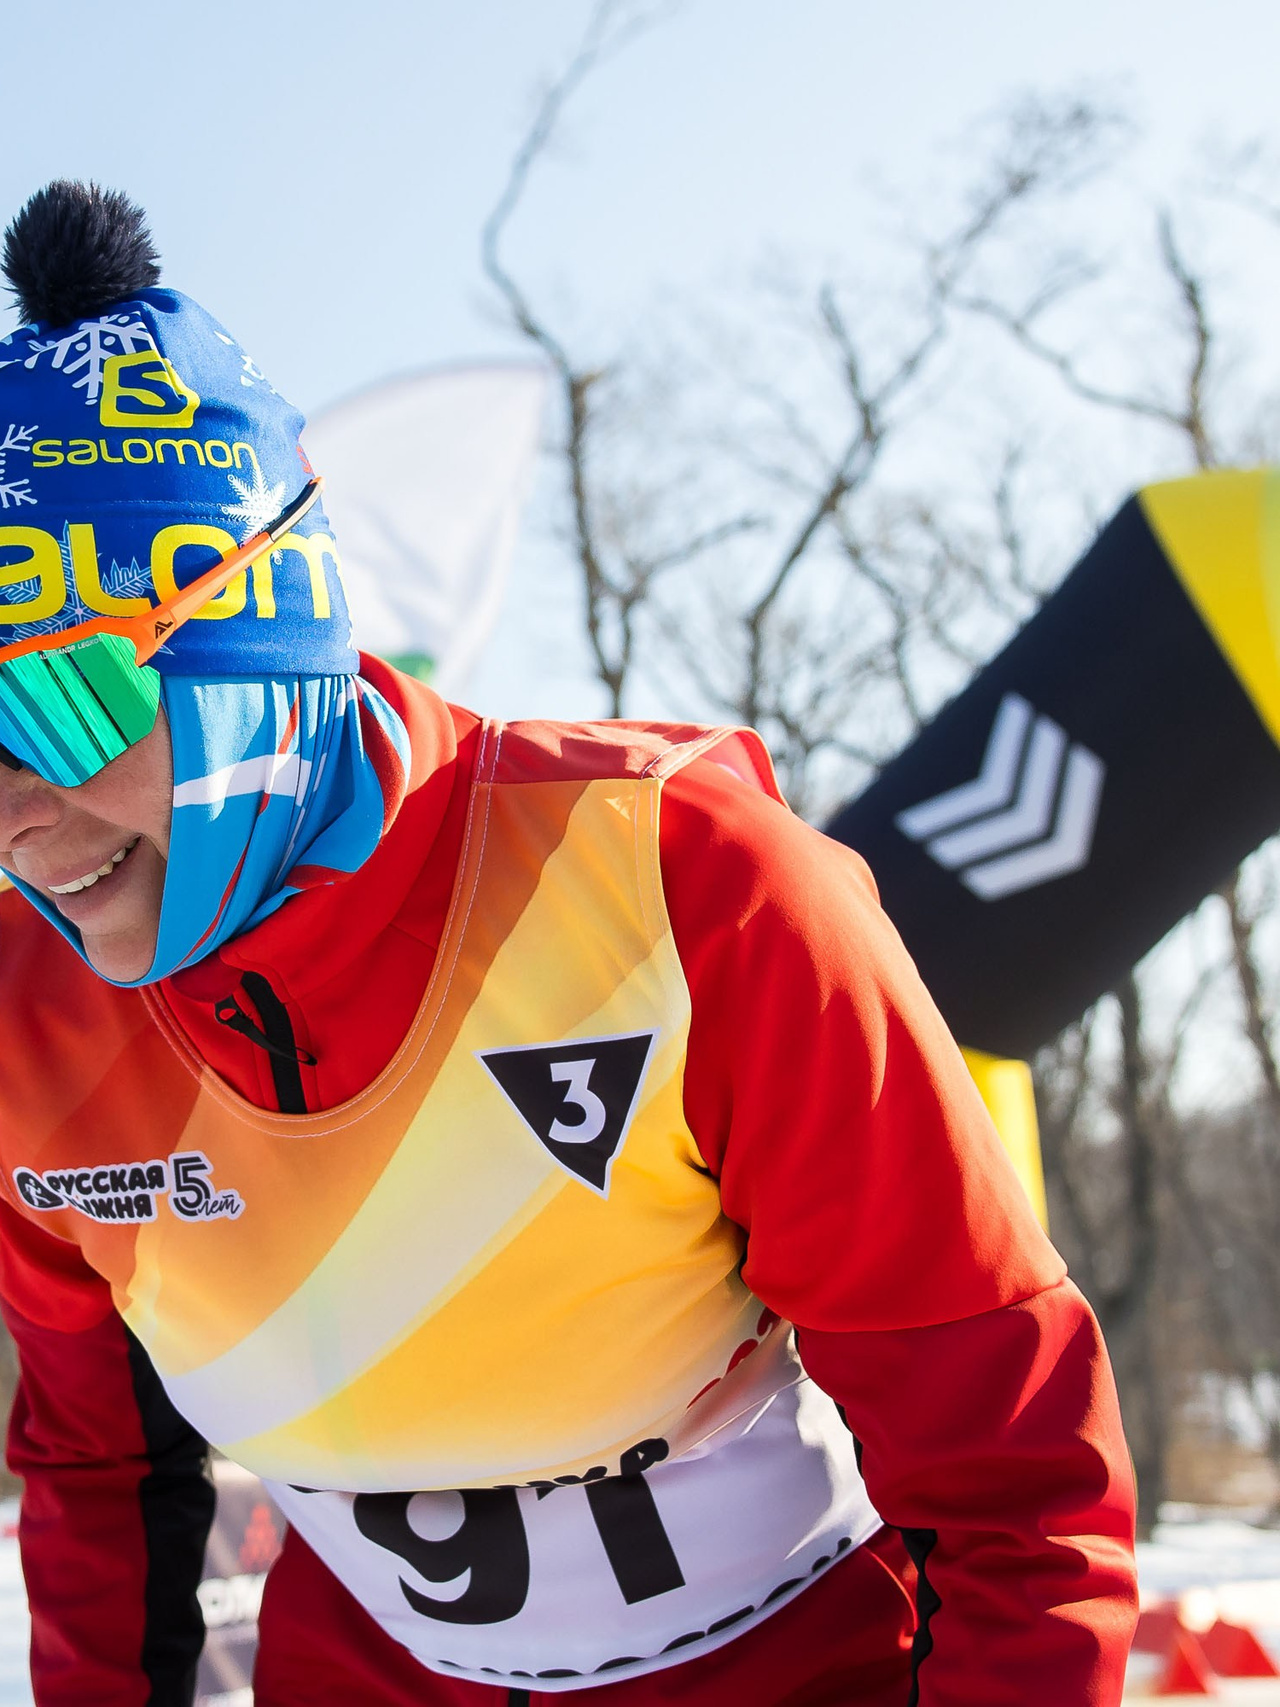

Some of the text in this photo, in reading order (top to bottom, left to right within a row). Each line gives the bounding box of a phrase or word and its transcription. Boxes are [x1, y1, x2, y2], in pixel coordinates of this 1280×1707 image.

[548, 1058, 607, 1144] 3
[46, 1165, 165, 1196] РУССКАЯ
[173, 1156, 241, 1217] 5 лет
